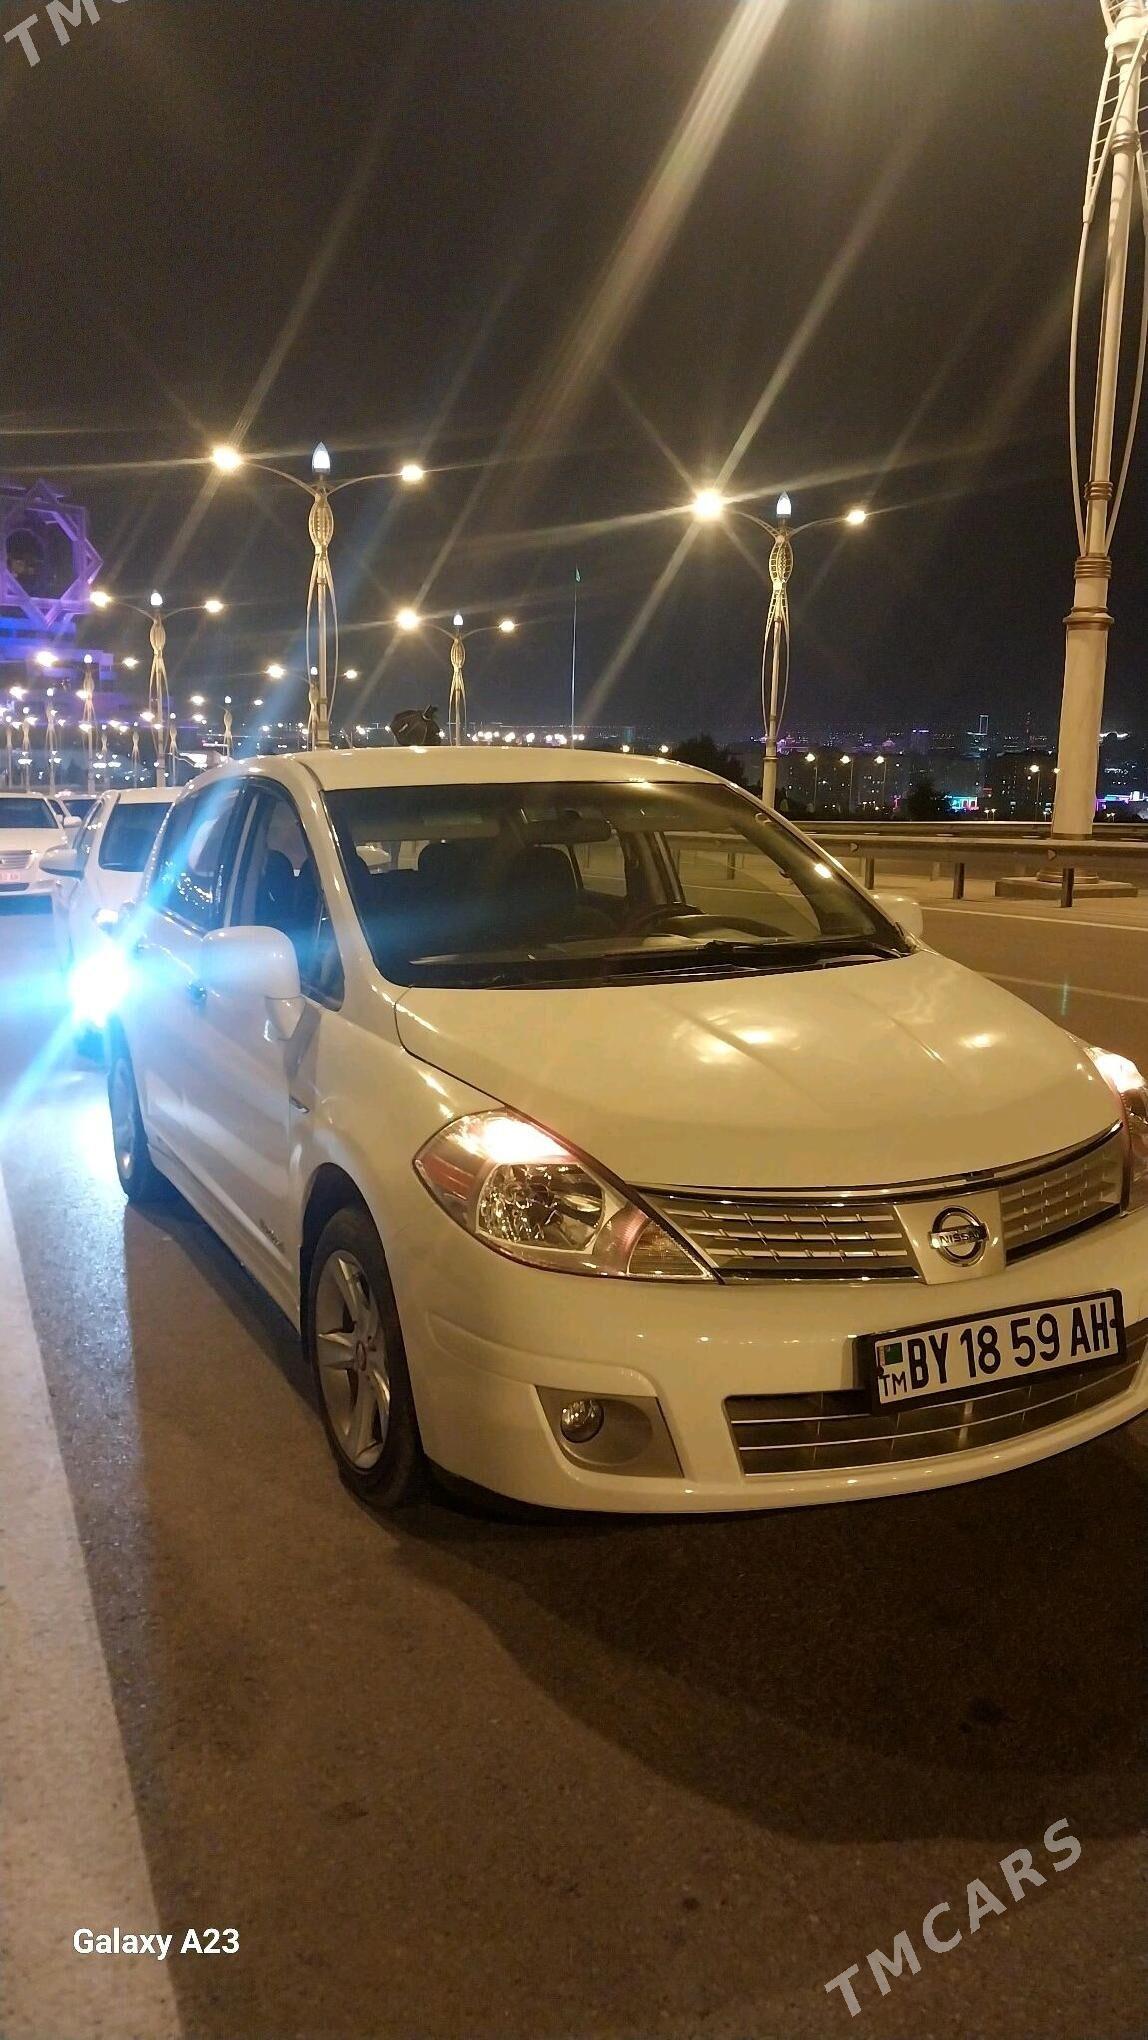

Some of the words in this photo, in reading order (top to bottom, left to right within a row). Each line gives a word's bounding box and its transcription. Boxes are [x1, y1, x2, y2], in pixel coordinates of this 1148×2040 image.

[907, 1332, 948, 1390] BY
[959, 1325, 1001, 1378] 18
[1010, 1313, 1060, 1368] 59
[1070, 1302, 1110, 1357] AH
[879, 1371, 907, 1397] TM
